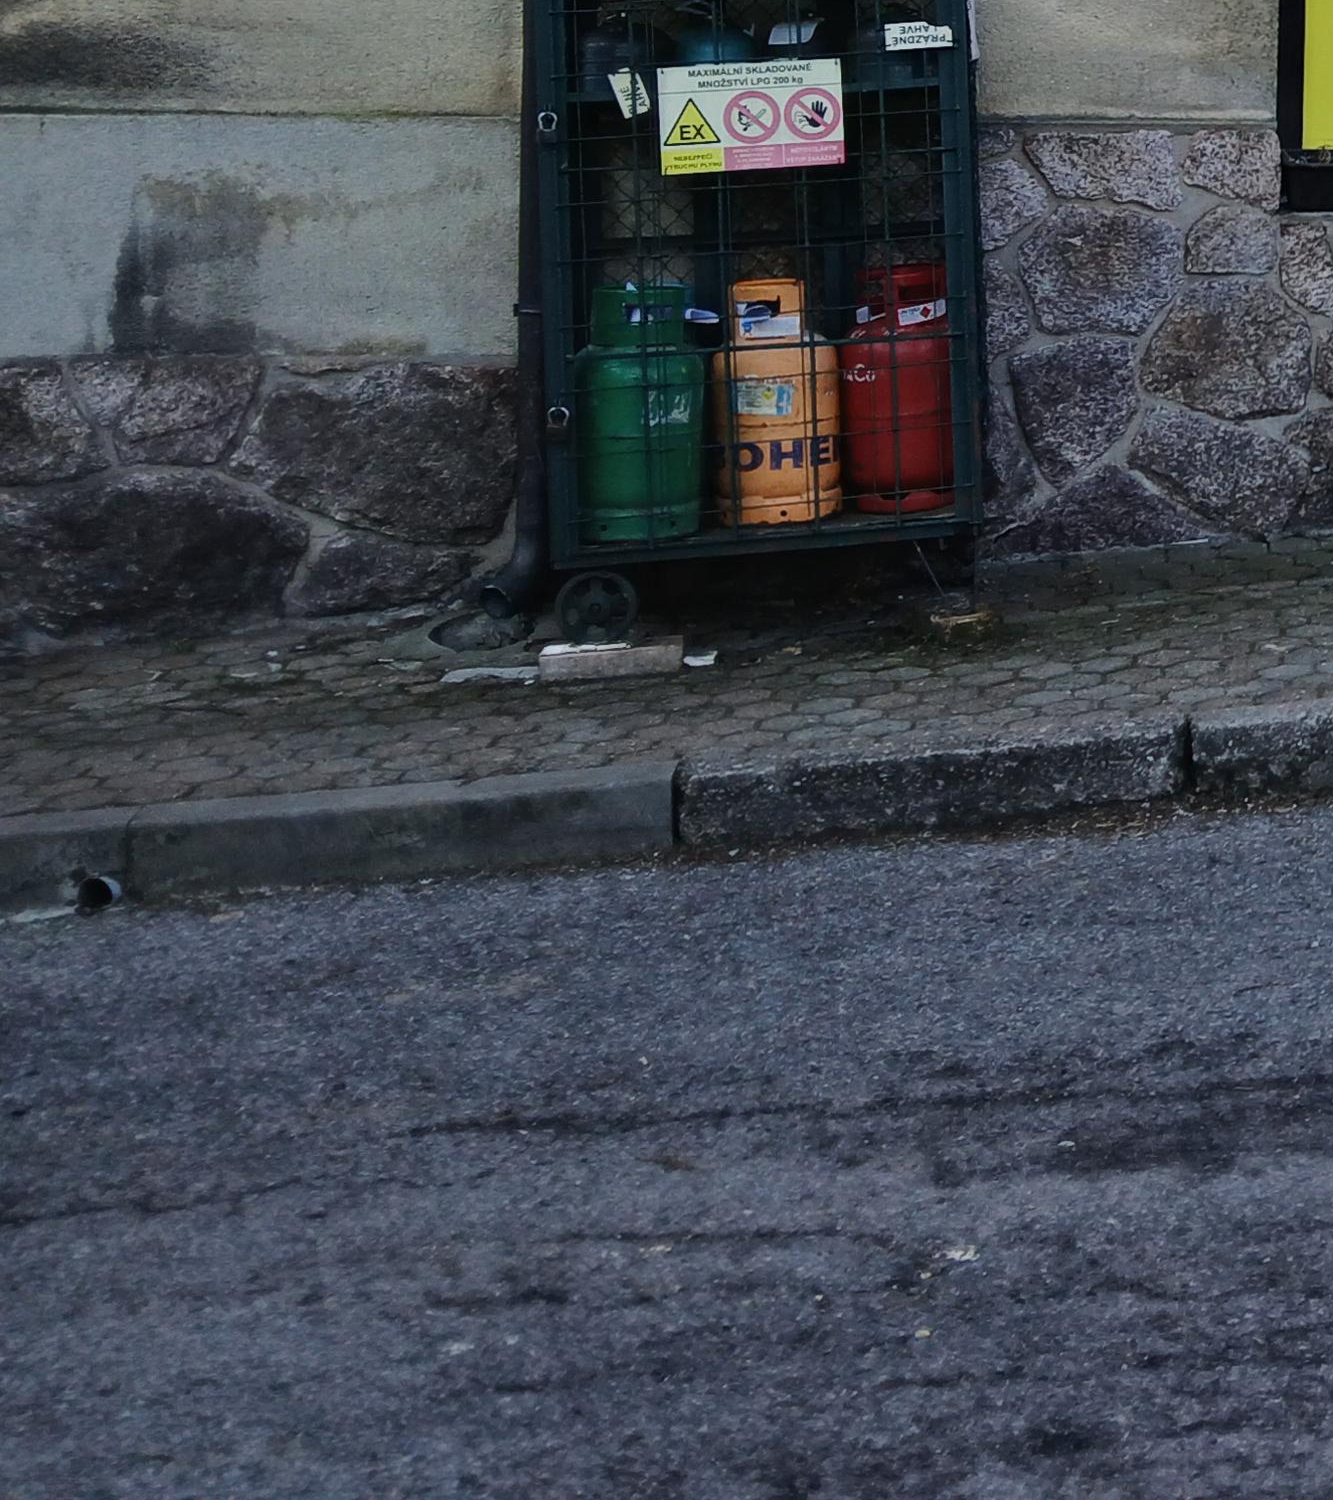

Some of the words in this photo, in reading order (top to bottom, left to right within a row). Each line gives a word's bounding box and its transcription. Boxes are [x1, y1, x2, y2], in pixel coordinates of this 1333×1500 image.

[687, 67, 743, 78] MAXIMÁLNÍ
[745, 62, 813, 74] SKLADOVANÉ
[698, 77, 749, 89] MNOŽSTVÍ
[750, 78, 771, 86] LPG
[773, 76, 789, 85] 200
[791, 76, 804, 85] kg
[679, 124, 707, 141] EX
[706, 435, 841, 473] OHE
